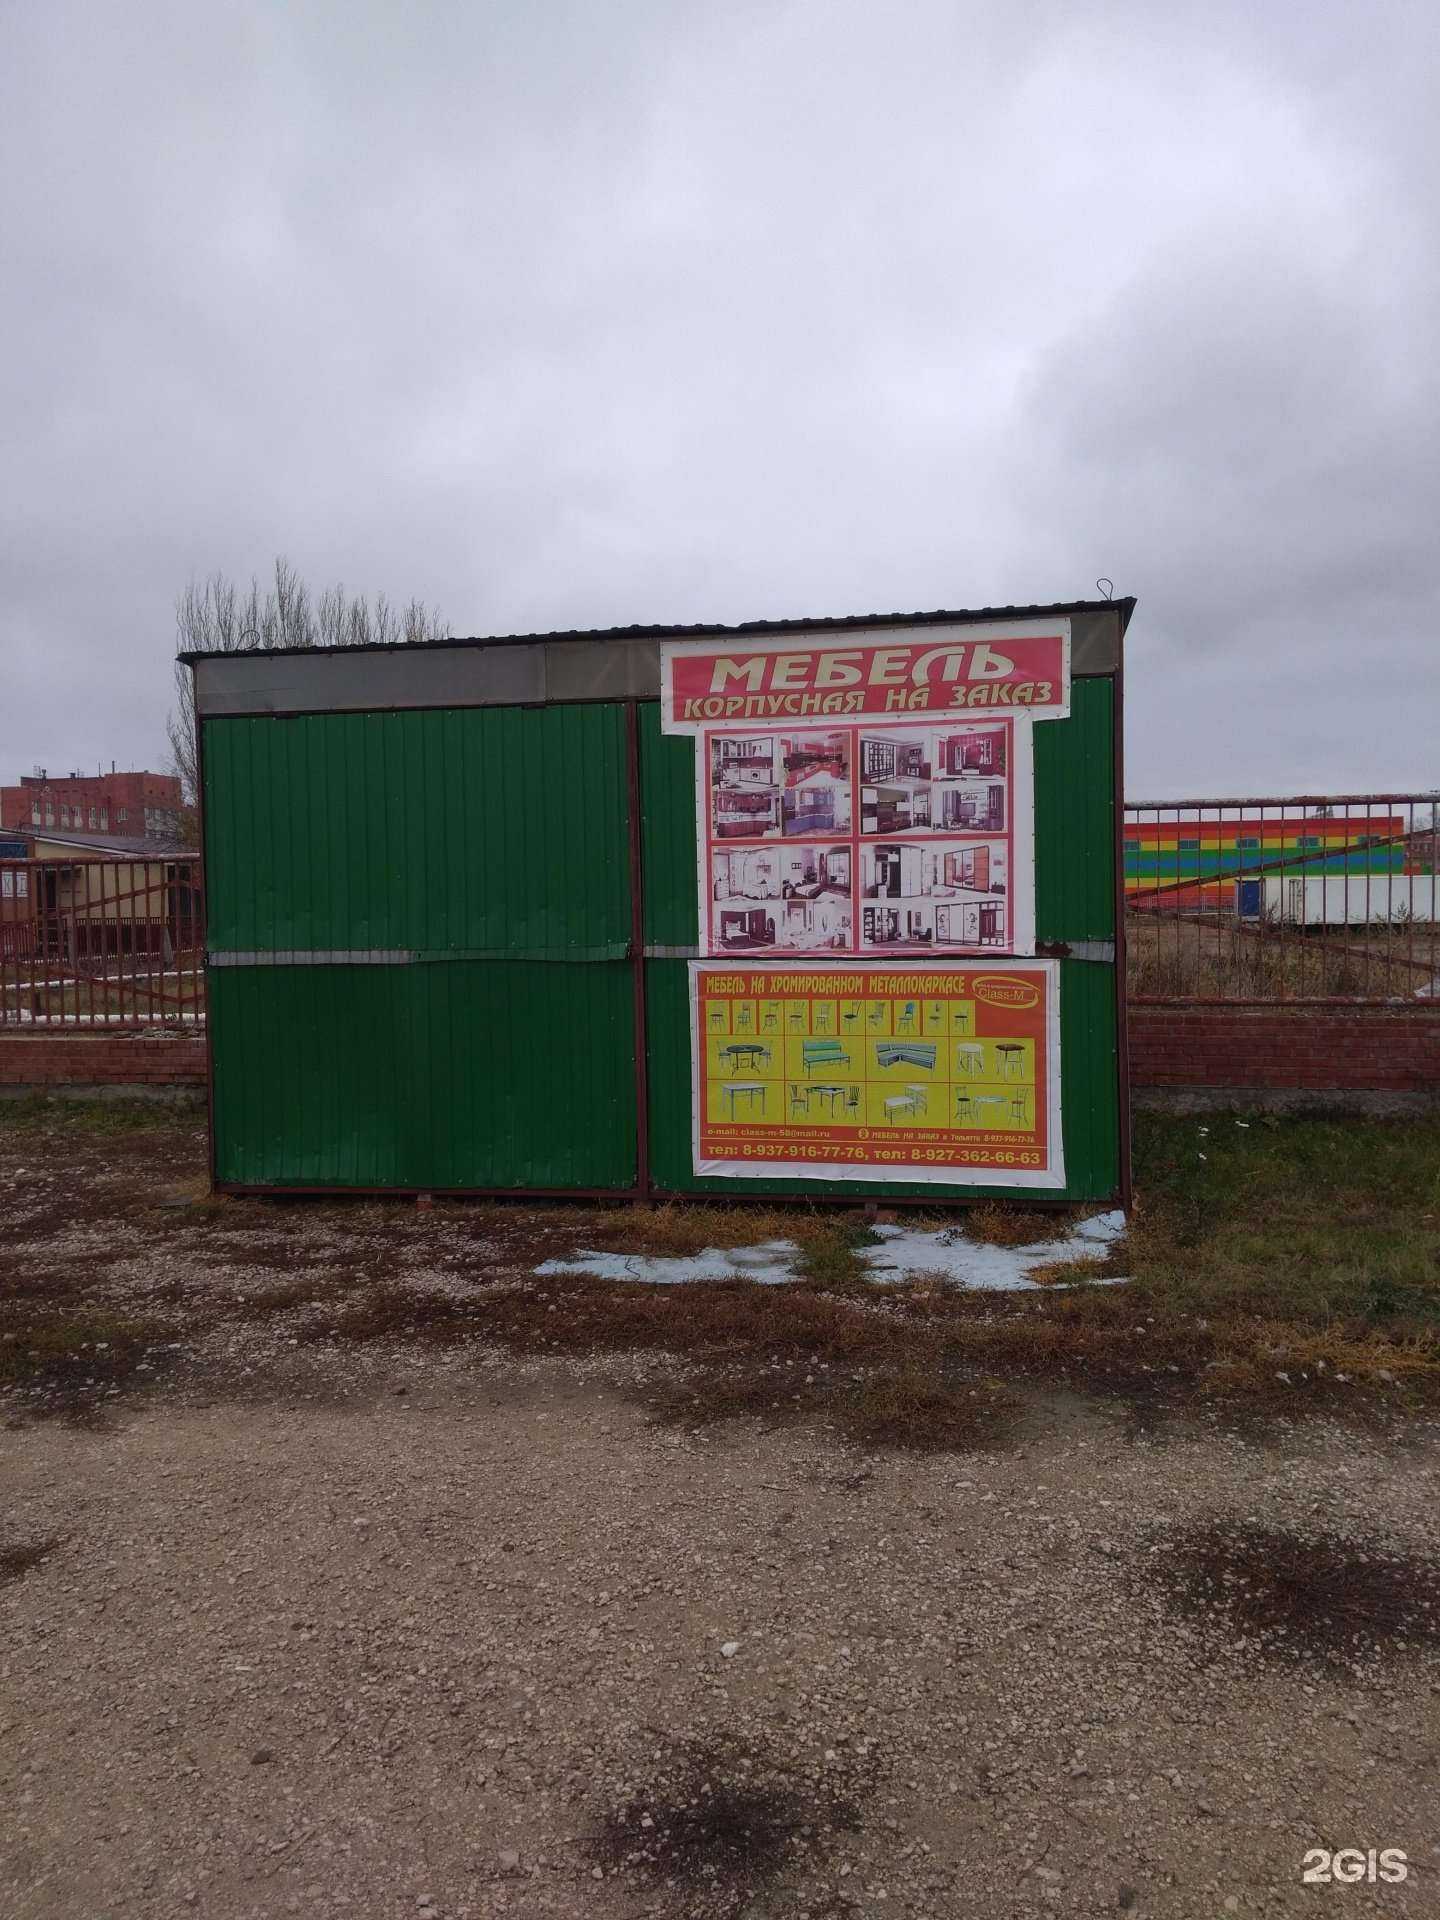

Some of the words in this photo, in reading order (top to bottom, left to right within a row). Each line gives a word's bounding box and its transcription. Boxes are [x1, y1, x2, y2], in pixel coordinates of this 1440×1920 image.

[709, 644, 1015, 693] МЕБЕЛЬ
[684, 691, 865, 719] КОРПУСНАЯ
[884, 687, 930, 711] НА
[952, 681, 1053, 706] ЗАКАЗ
[706, 976, 746, 994] МЕБЕЛЬ
[751, 976, 765, 994] НА
[770, 976, 863, 995] ХРОМИРОВАННОМ
[869, 976, 965, 995] МЕТАЛЛОКАРКАСЕ
[978, 987, 1024, 1001] Class-M
[742, 1144, 869, 1160] 8-937-916-77-76,
[911, 1149, 1041, 1165] 8-927-362-66-63
